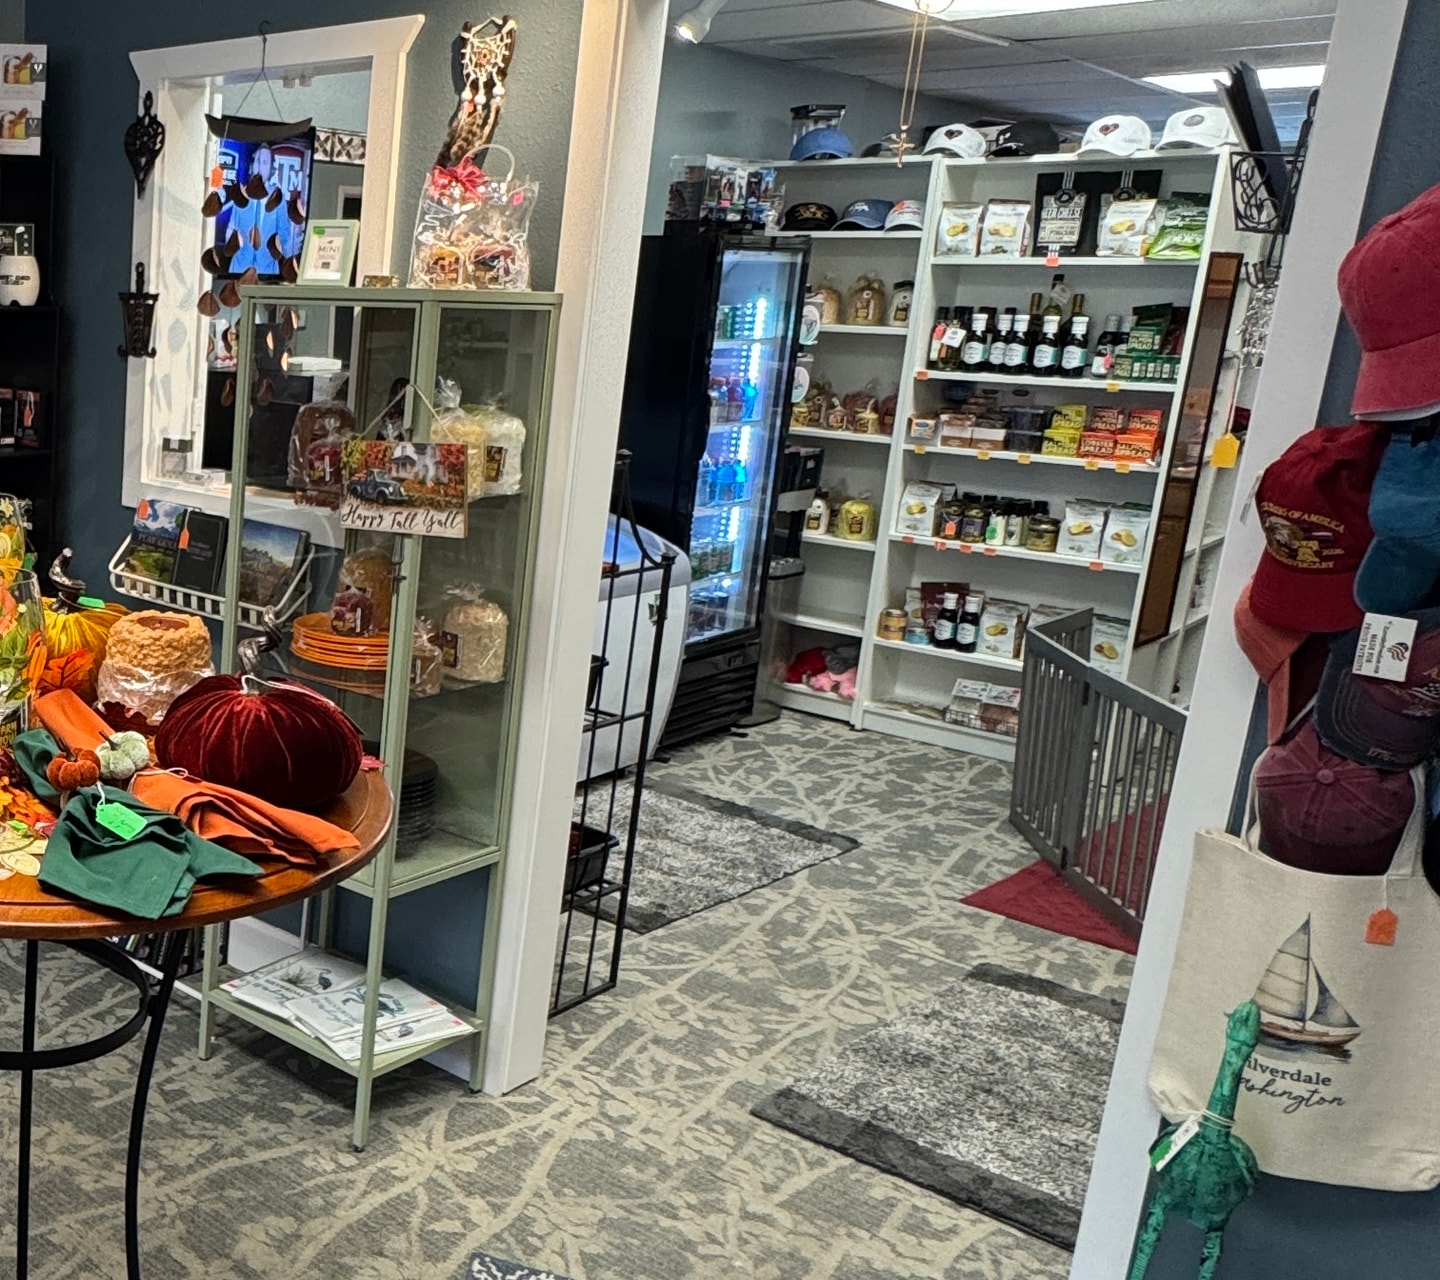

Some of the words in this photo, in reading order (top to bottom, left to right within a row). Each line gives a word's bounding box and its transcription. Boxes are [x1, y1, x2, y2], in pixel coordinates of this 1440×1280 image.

[341, 503, 383, 528] Happy
[1301, 513, 1345, 533] AMERICA
[1246, 1058, 1332, 1086] ilverdale
[1239, 1077, 1346, 1114] ashington
